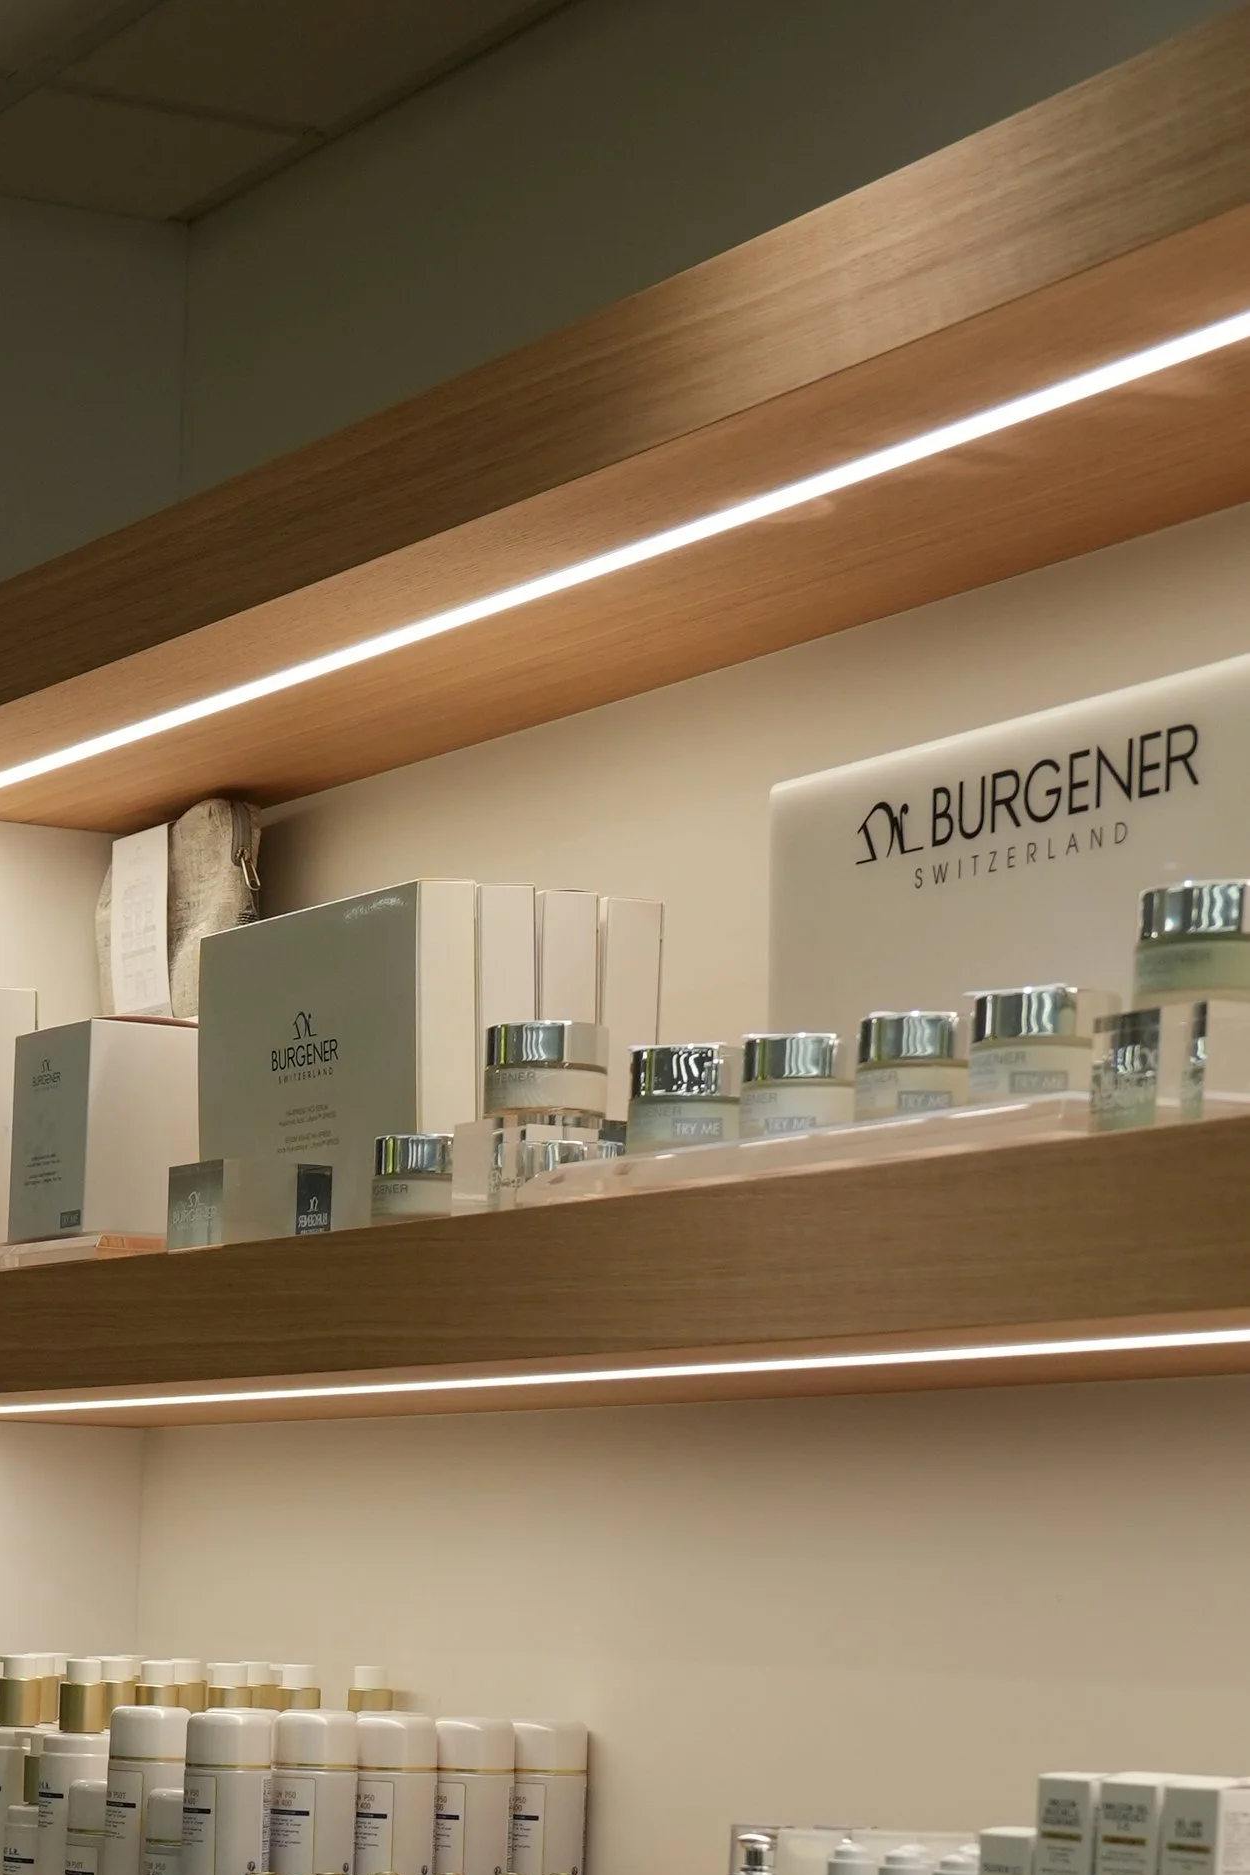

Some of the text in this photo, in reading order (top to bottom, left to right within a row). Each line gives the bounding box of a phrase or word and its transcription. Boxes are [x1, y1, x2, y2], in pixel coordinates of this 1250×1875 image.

[931, 722, 1200, 848] BURGENER
[913, 820, 1129, 891] SWITZERLAND
[271, 1037, 339, 1072] BURGENER
[278, 1065, 334, 1085] SWITZERLAND
[674, 1120, 722, 1137] TRY ME
